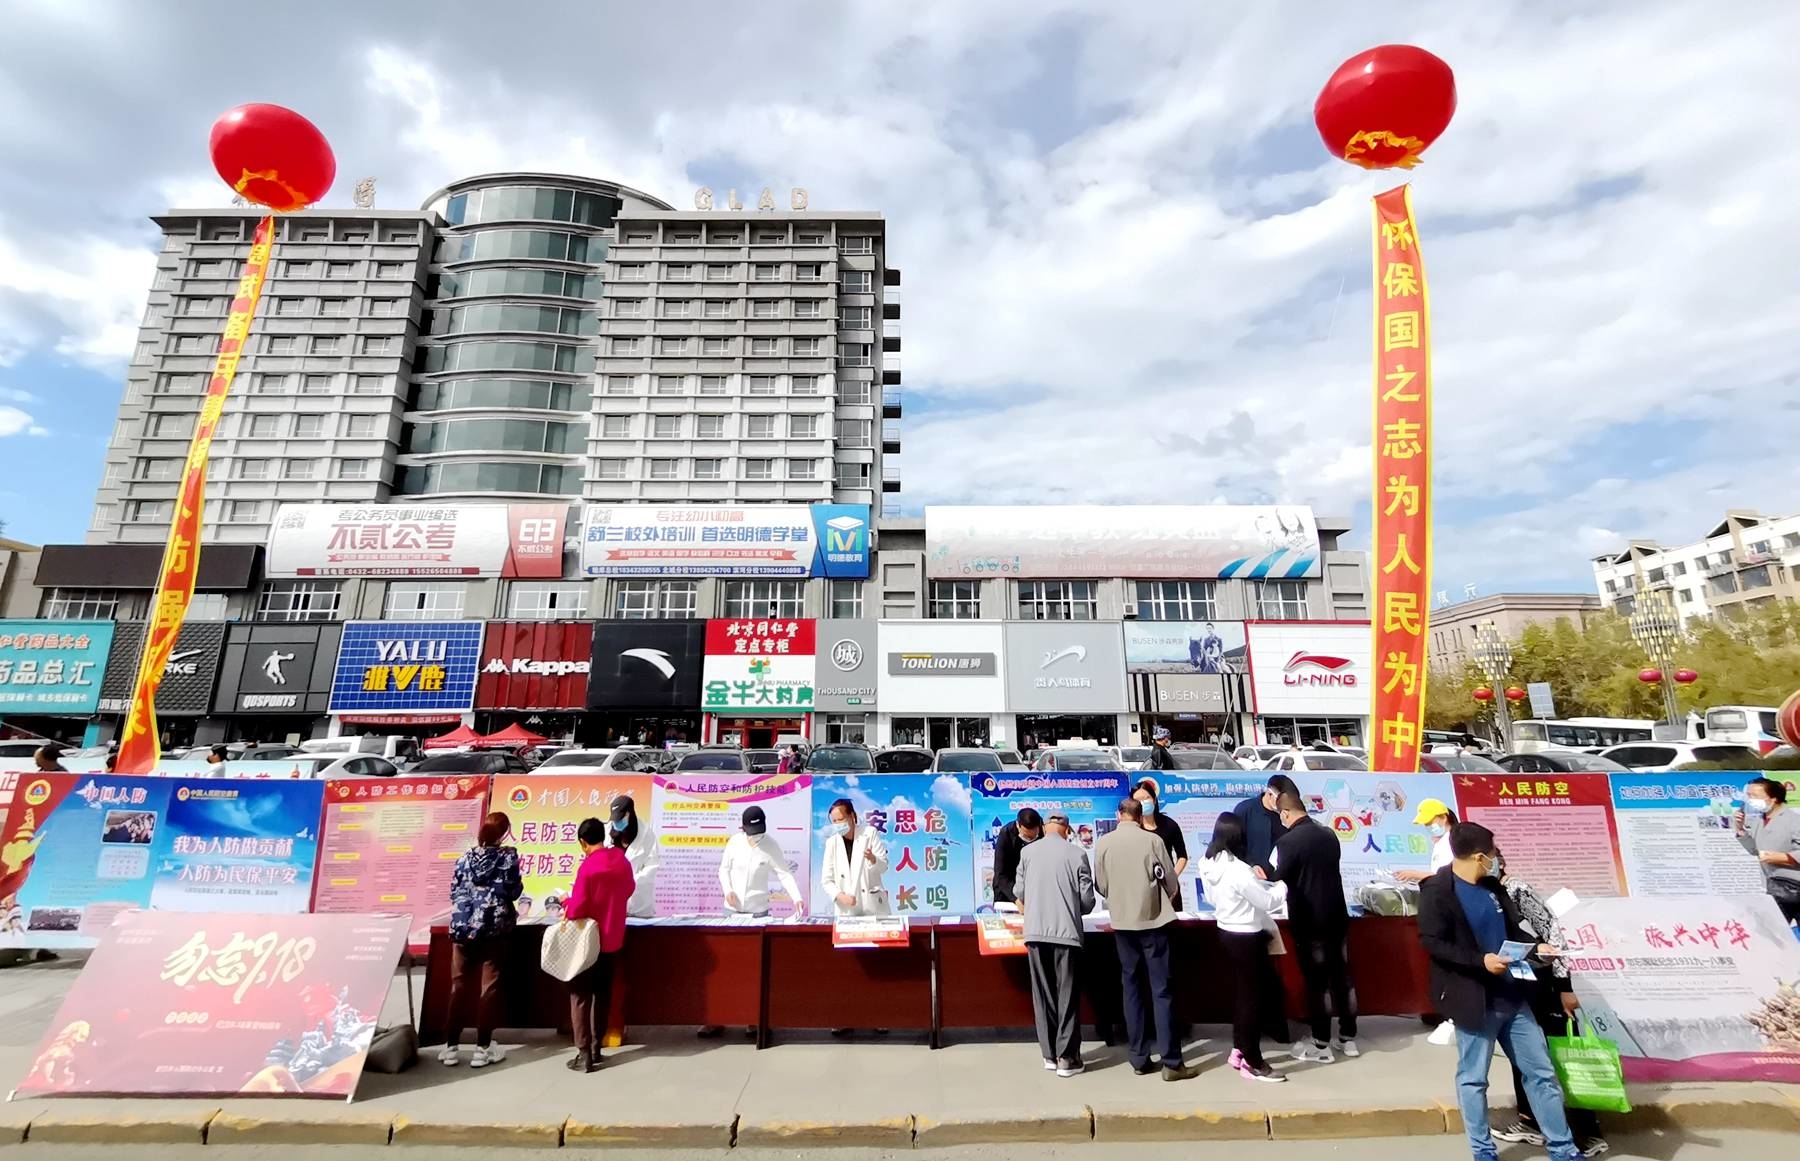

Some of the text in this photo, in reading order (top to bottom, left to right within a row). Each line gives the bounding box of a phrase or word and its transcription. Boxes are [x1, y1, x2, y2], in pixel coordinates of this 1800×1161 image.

[694, 186, 809, 209] GLAD
[327, 523, 456, 550] 不贰公考
[587, 526, 808, 543] 舒兰校外培训 首选明德学堂
[828, 553, 863, 563] 明德教育
[726, 621, 799, 638] 北京同仁堂
[734, 638, 789, 654] 定点专柜
[1132, 637, 1158, 645] BUSEN
[377, 640, 448, 662] YALU
[837, 643, 858, 665] 城
[512, 659, 590, 676] Kappa
[901, 657, 958, 670] TONLION
[1283, 674, 1358, 687] LI-NING
[705, 680, 814, 706] 金牛大药房
[817, 687, 877, 696] THOUSAND CITY
[1160, 689, 1221, 702] BUSEN 步森
[243, 695, 297, 709] QDSPORTS
[84, 786, 148, 803] 中国人防
[685, 783, 786, 795] 人民防空和防护技能
[1165, 783, 1218, 793] 加强人防建设
[1498, 781, 1570, 797] 人民防空
[174, 835, 294, 857] 我为人防做贡献
[518, 853, 587, 875] 好防空
[895, 845, 948, 872] 人防
[179, 863, 298, 884] 人防为民保平安
[895, 884, 949, 911] 长鸣
[1643, 918, 1751, 950] 振兴中华
